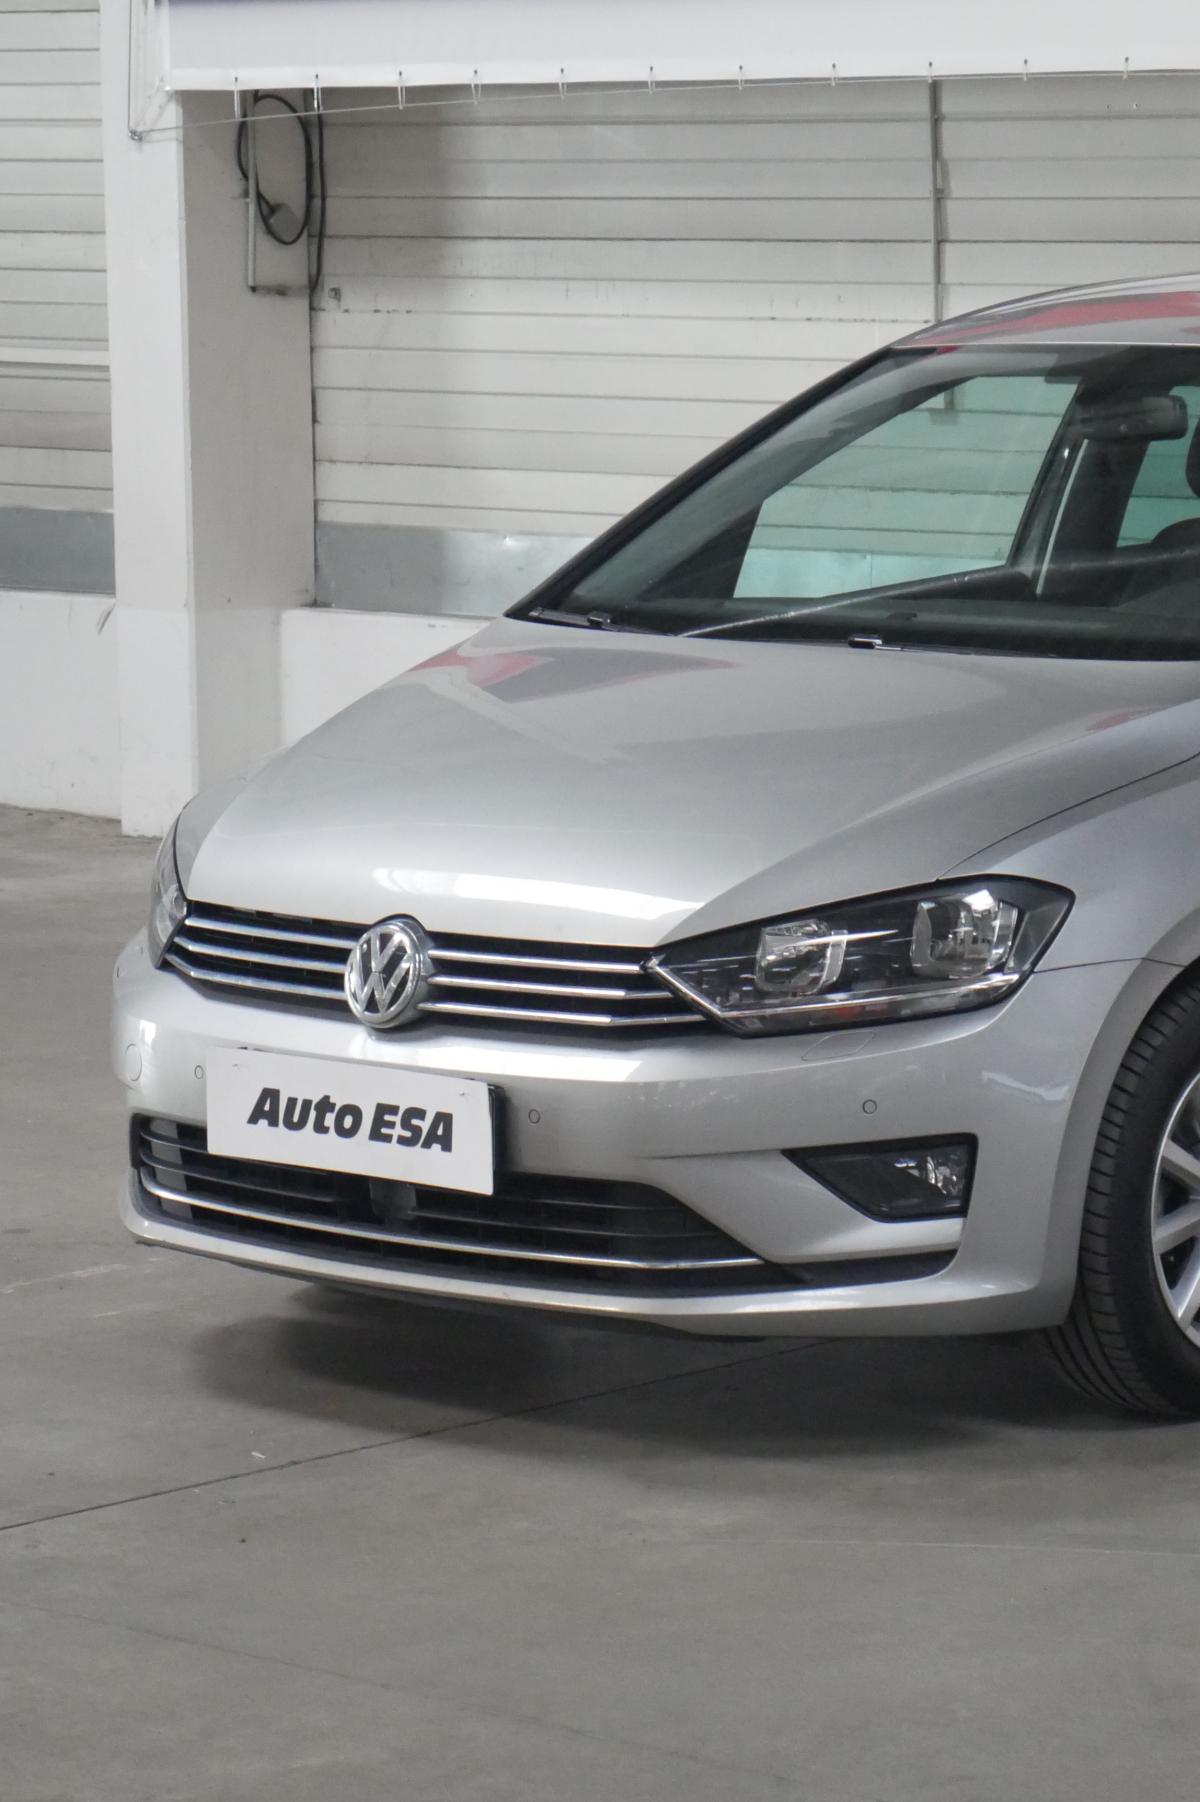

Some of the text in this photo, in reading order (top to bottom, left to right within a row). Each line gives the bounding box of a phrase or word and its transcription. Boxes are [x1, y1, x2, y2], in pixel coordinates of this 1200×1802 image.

[346, 923, 418, 1023] VW
[246, 1087, 454, 1153] Auto ESA
